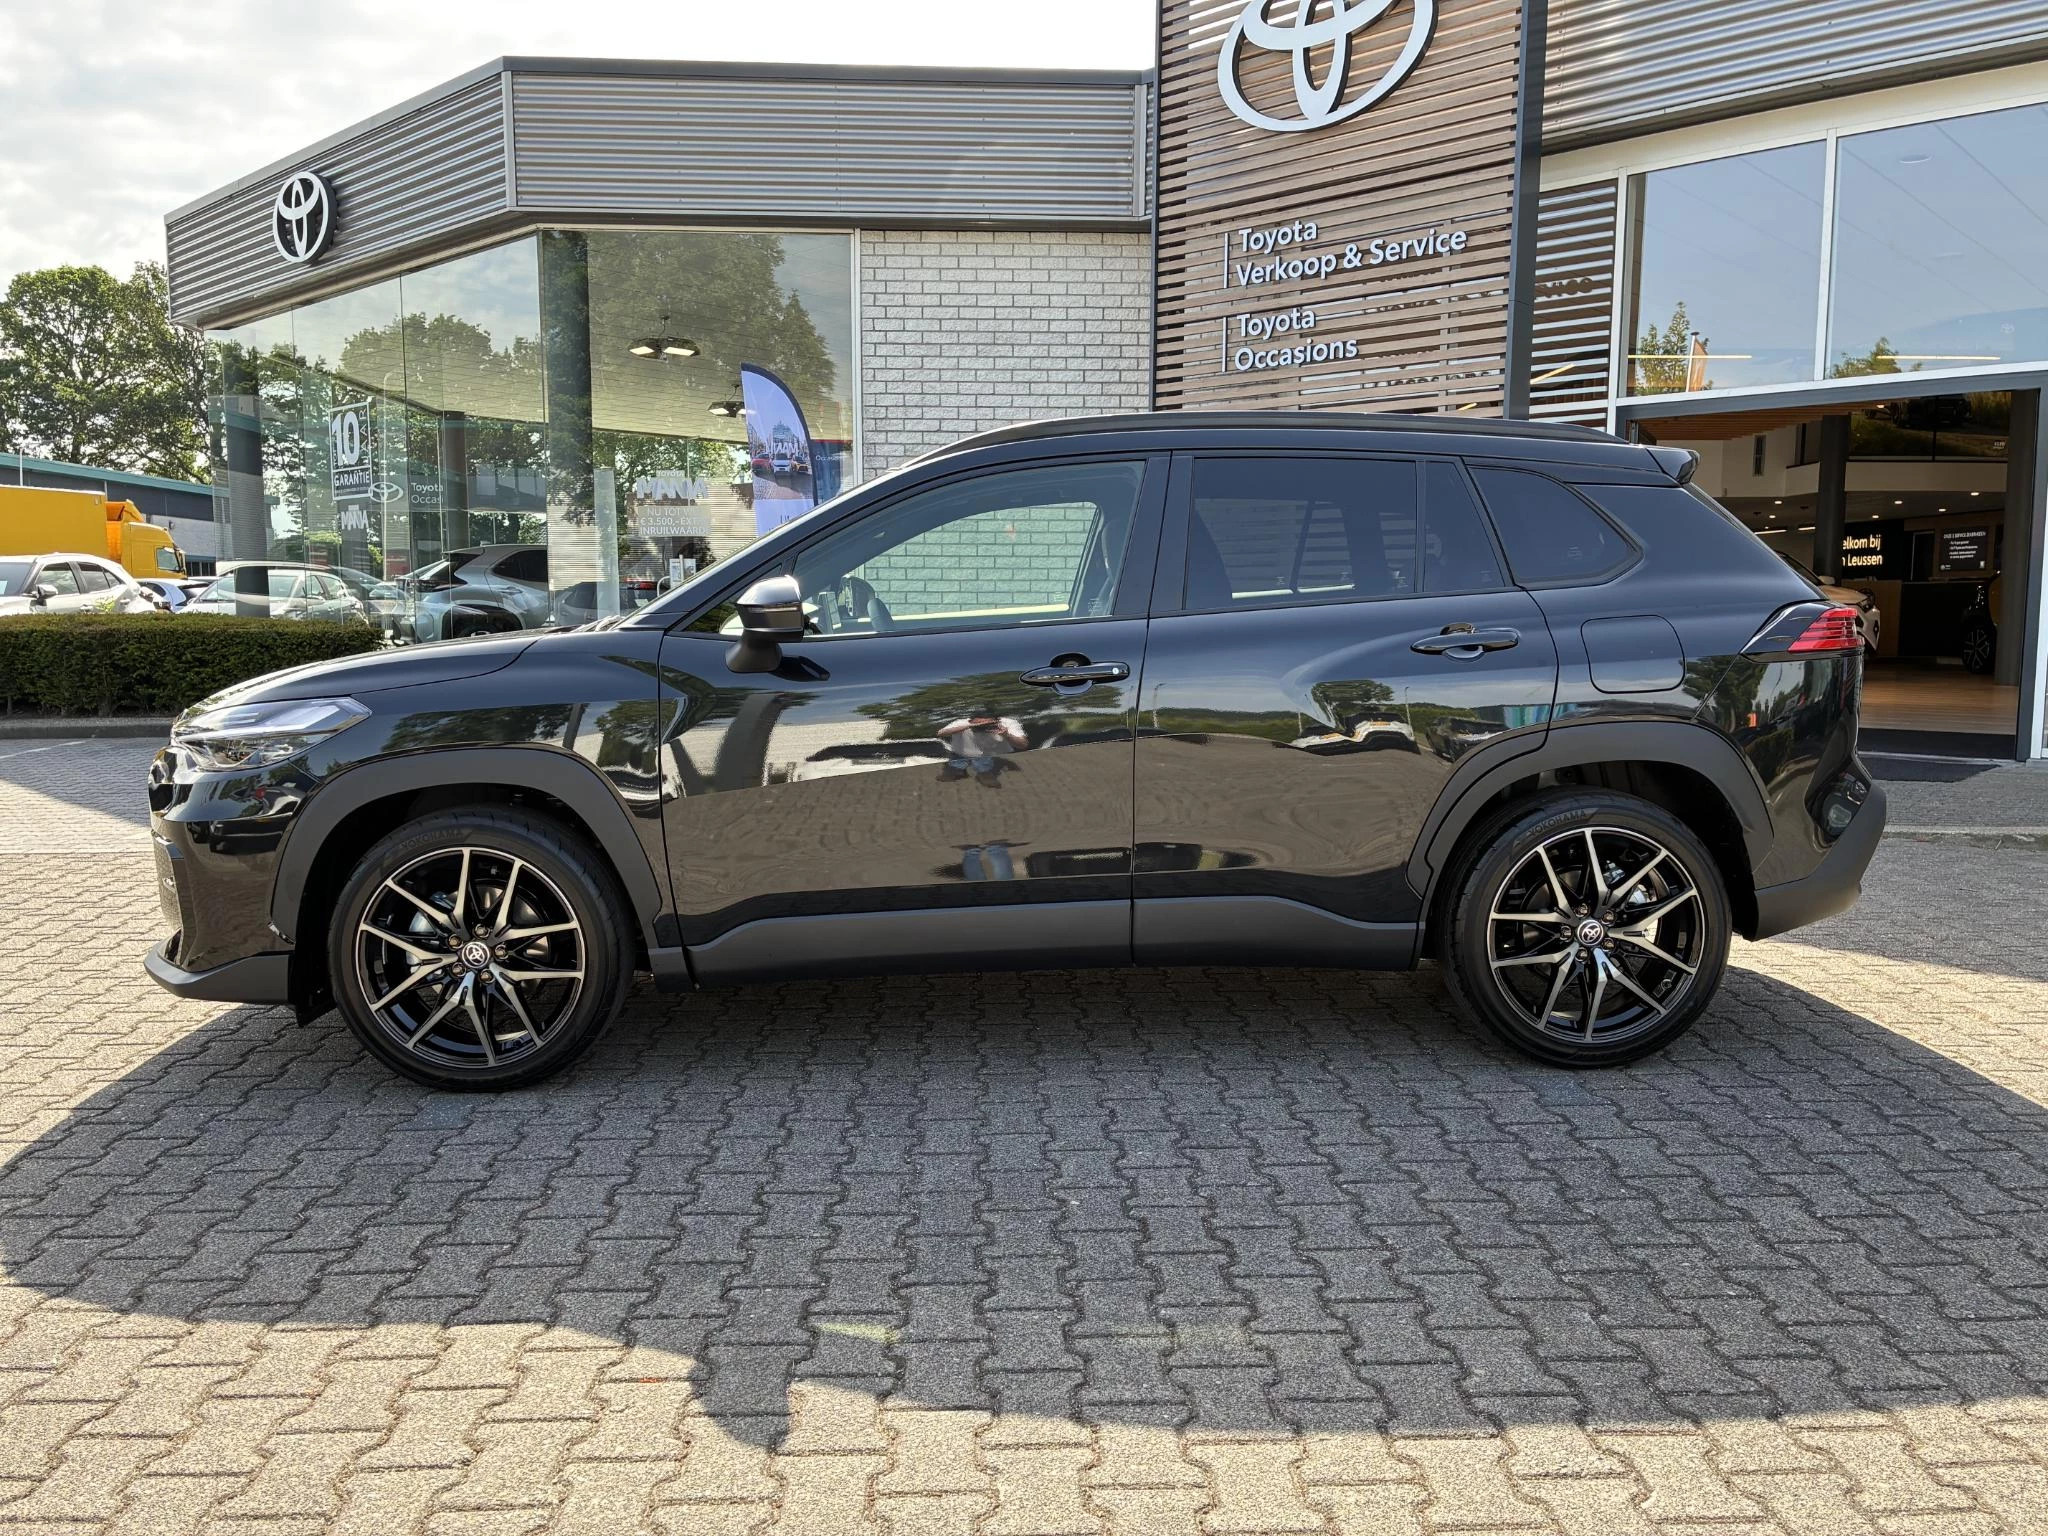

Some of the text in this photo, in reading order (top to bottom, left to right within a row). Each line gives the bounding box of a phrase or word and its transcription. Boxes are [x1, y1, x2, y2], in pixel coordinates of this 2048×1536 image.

[1238, 220, 1318, 254] Toyota
[1236, 228, 1468, 286] Verkoop & Service
[1237, 307, 1316, 341] Toyota
[1235, 338, 1359, 372] Occasions
[332, 411, 360, 466] 10
[334, 471, 370, 486] GARANTIE
[411, 494, 443, 504] Occasi
[1842, 533, 1881, 551] elkom bij
[1847, 553, 1883, 567] Leussen
